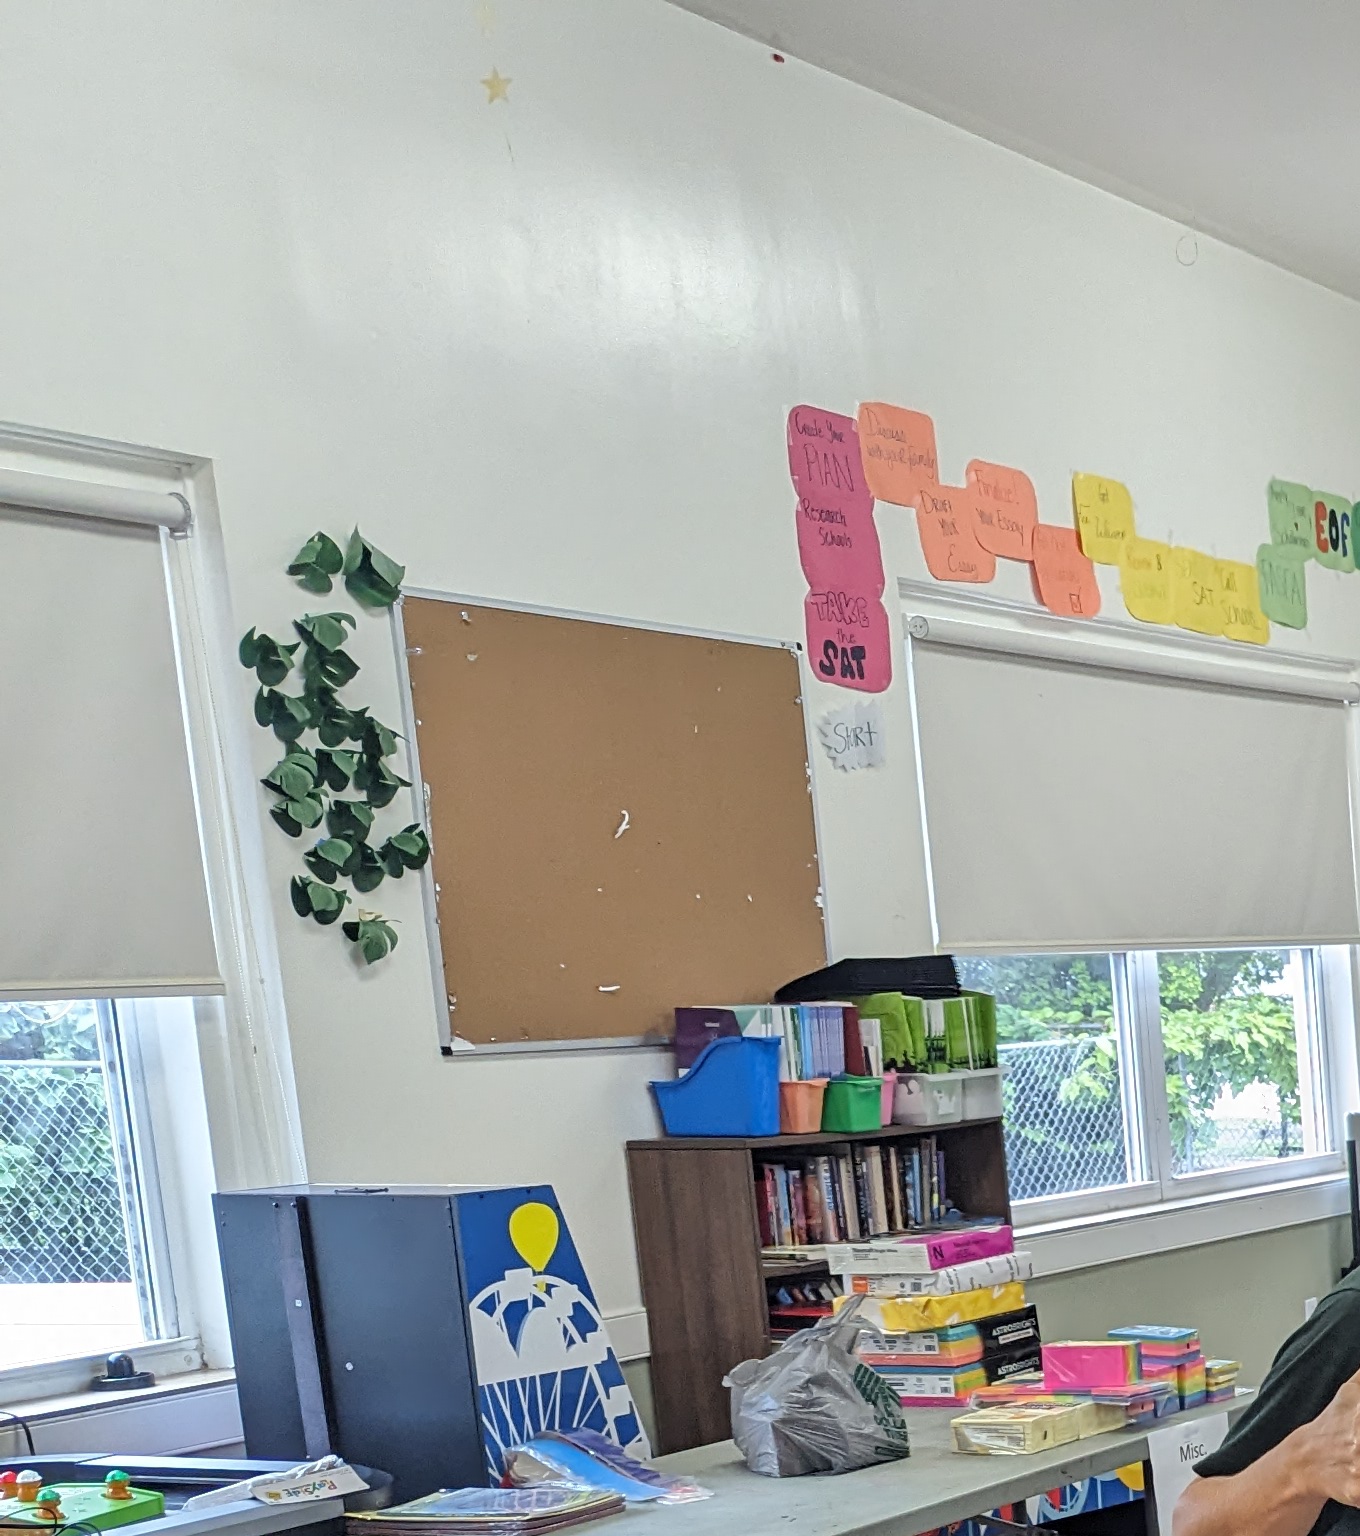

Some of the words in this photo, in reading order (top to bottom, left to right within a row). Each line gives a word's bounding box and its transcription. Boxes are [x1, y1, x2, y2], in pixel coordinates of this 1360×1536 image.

[1314, 500, 1351, 558] EOF
[811, 591, 870, 628] TAKE
[836, 628, 857, 645] the
[819, 639, 866, 681] SAT
[1178, 1442, 1207, 1464] Misc.
